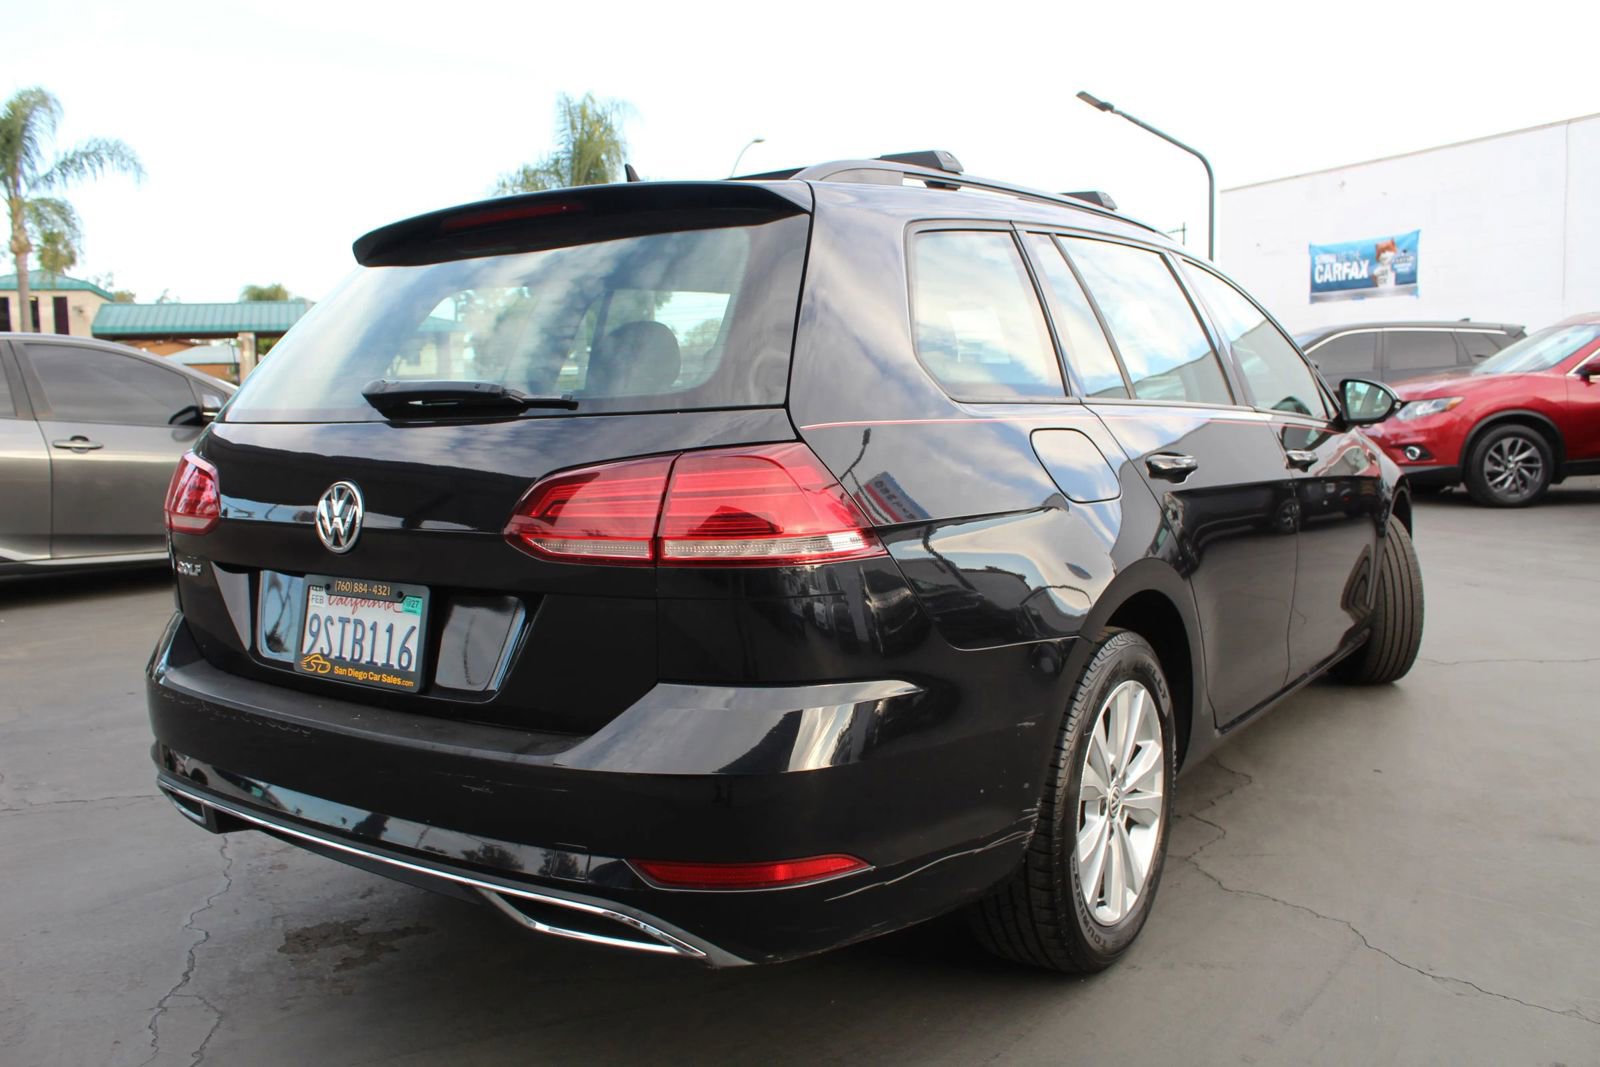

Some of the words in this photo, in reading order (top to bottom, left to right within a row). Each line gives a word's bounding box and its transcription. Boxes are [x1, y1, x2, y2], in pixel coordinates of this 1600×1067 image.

[1314, 259, 1370, 284] CARFAX
[334, 665, 347, 675] San
[348, 668, 368, 680] Diego
[368, 672, 381, 681] Car
[381, 674, 414, 687] Sales.com
